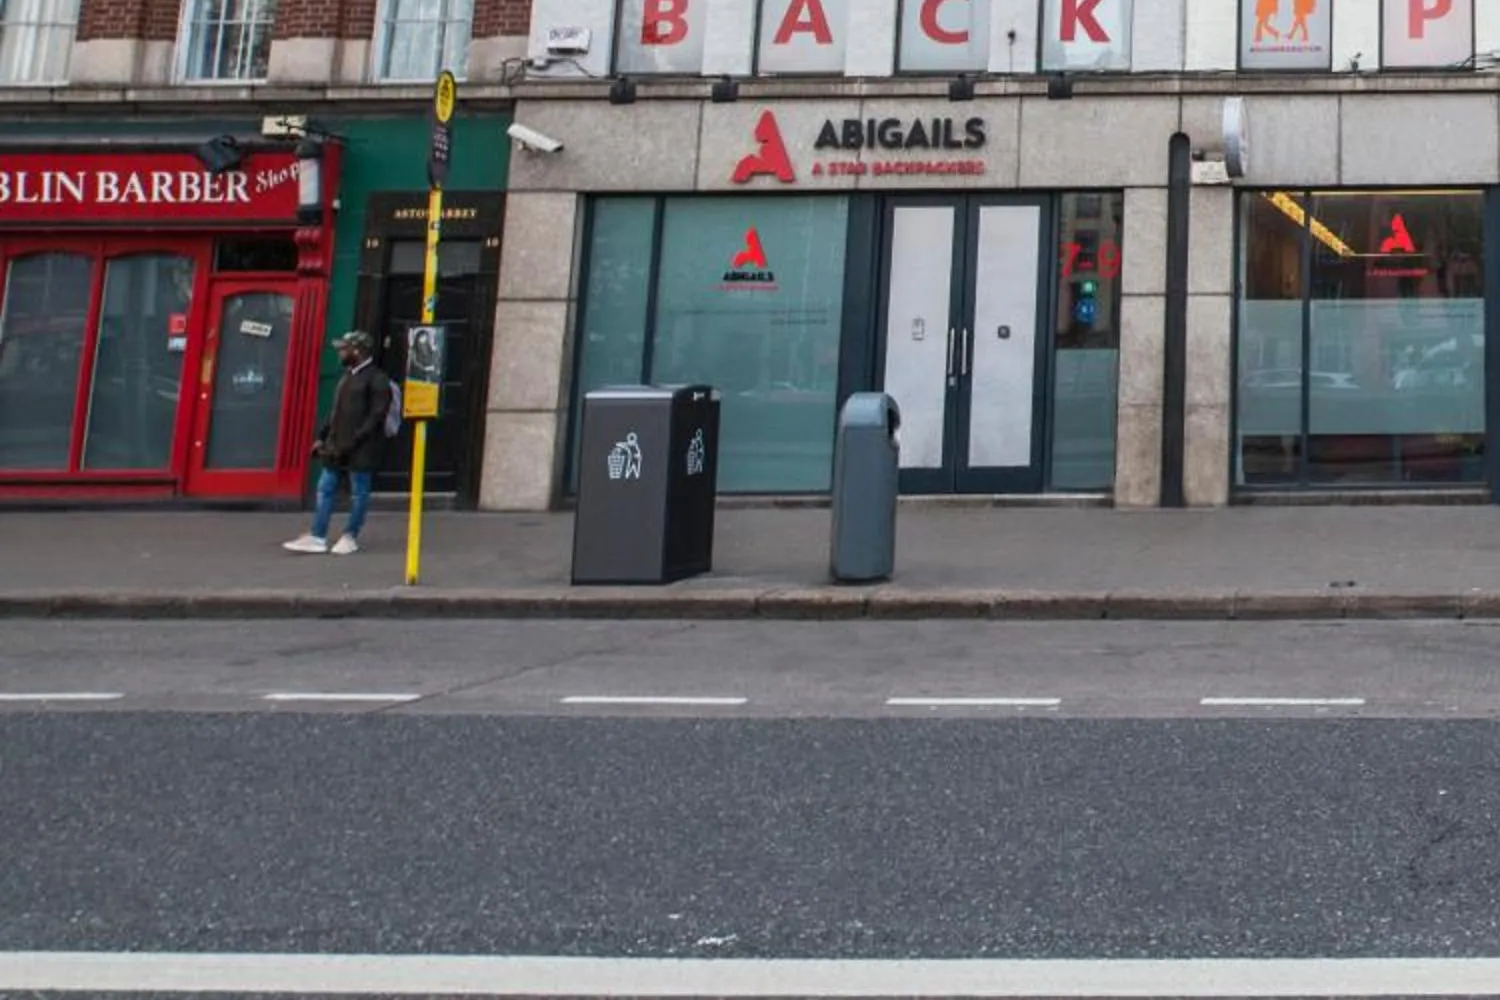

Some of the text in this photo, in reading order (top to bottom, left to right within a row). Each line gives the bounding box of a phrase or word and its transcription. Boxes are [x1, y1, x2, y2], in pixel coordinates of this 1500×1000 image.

[813, 117, 987, 149] ABIGAILS
[96, 171, 250, 202] BARBER
[394, 207, 433, 219] ASTO
